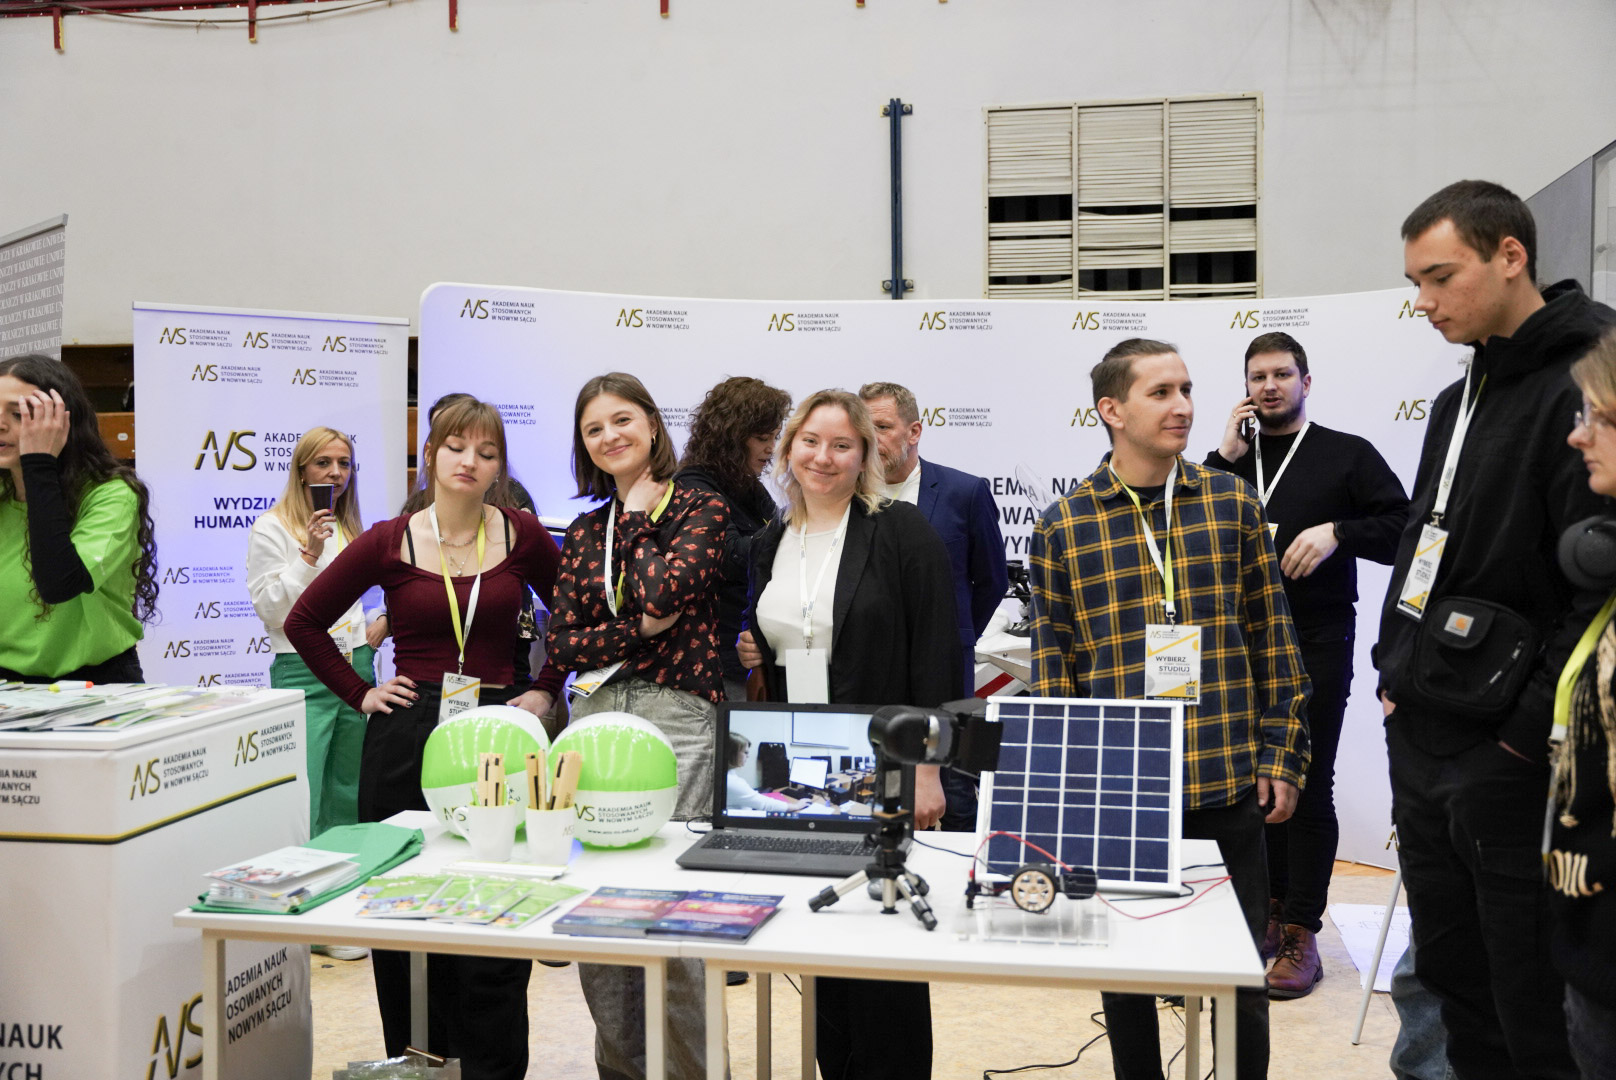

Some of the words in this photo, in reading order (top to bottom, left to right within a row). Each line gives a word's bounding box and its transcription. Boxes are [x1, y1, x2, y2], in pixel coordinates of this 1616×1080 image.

[264, 462, 275, 471] W
[214, 498, 277, 510] WYDZIA
[194, 516, 257, 528] HUMAN
[261, 725, 283, 736] AKADEMIA
[285, 720, 295, 729] NAUK
[261, 732, 292, 747] STOSOWANYCH
[164, 752, 191, 765] AKADEMIA
[193, 747, 207, 758] NAUK
[267, 746, 283, 757] NOWYM
[12, 770, 37, 778] NAUK
[164, 759, 204, 777] STOSOWANYCH
[171, 774, 192, 788] NOWYM
[12, 795, 40, 806] SĄCZU
[226, 963, 262, 997] ADEMIA
[264, 947, 287, 973] NAUK
[227, 972, 282, 1020] OSOWANYCH
[228, 1008, 264, 1044] NOWYM
[266, 989, 292, 1019] SĄCZU
[0, 1023, 63, 1050] AUK
